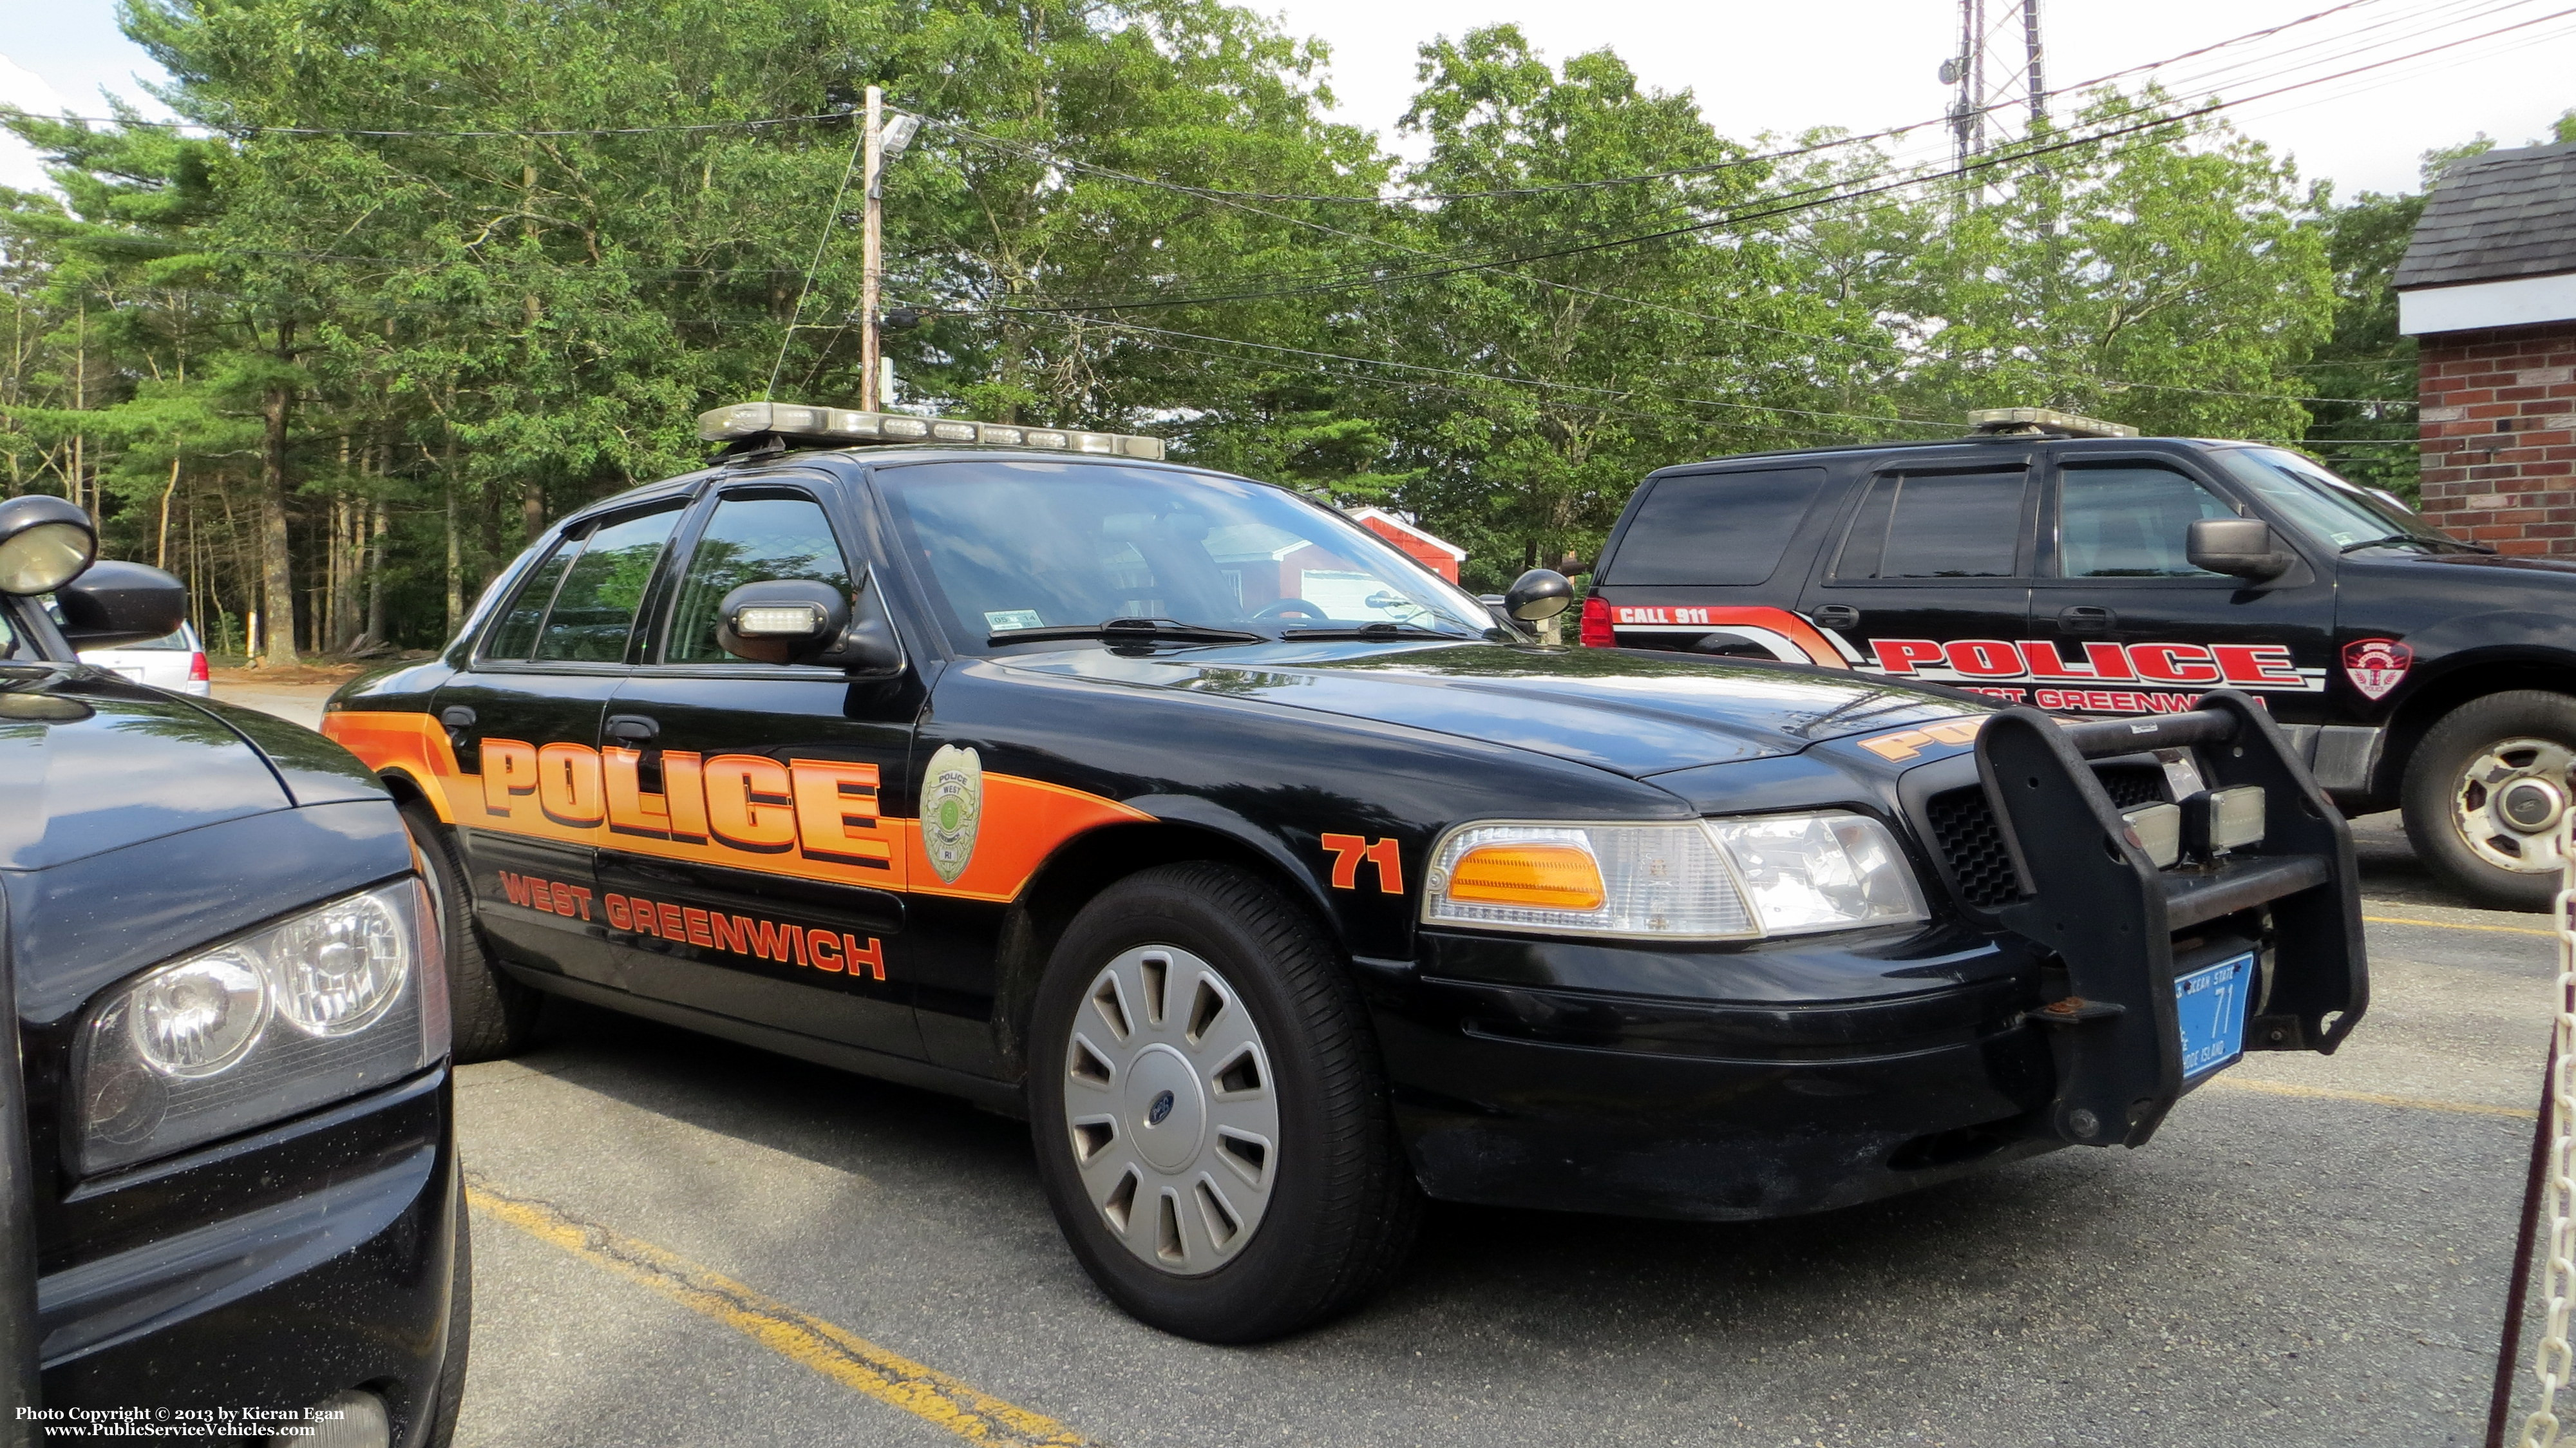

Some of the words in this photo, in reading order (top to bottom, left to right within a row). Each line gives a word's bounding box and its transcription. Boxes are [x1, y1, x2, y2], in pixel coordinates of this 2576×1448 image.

[1620, 607, 1669, 624] CALL
[1675, 607, 1710, 624] 911
[1868, 638, 2308, 685] POLICE
[939, 772, 968, 785] POLICE
[943, 785, 961, 795] WEST
[480, 738, 892, 870] POLICE
[944, 850, 952, 859] RI
[1321, 833, 1404, 895] 71
[499, 870, 594, 922] WEST
[606, 893, 886, 982] GREENWICH
[2212, 984, 2233, 1039] 71
